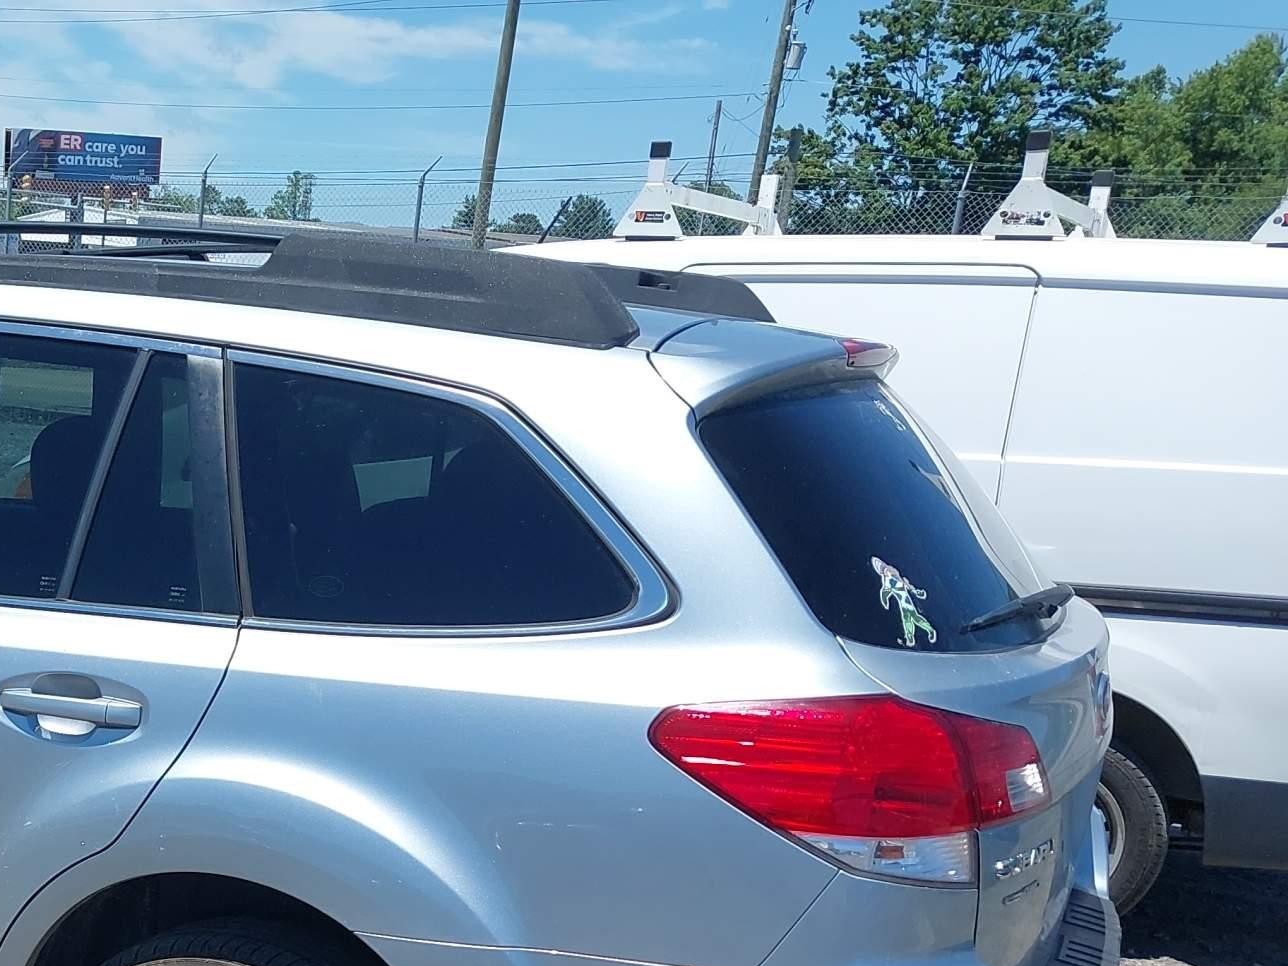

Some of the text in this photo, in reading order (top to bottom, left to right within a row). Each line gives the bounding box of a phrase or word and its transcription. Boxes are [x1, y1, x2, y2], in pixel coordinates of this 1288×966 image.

[60, 134, 82, 150] ER
[85, 141, 117, 153] care
[120, 143, 146, 157] you
[57, 154, 123, 169] can trust.
